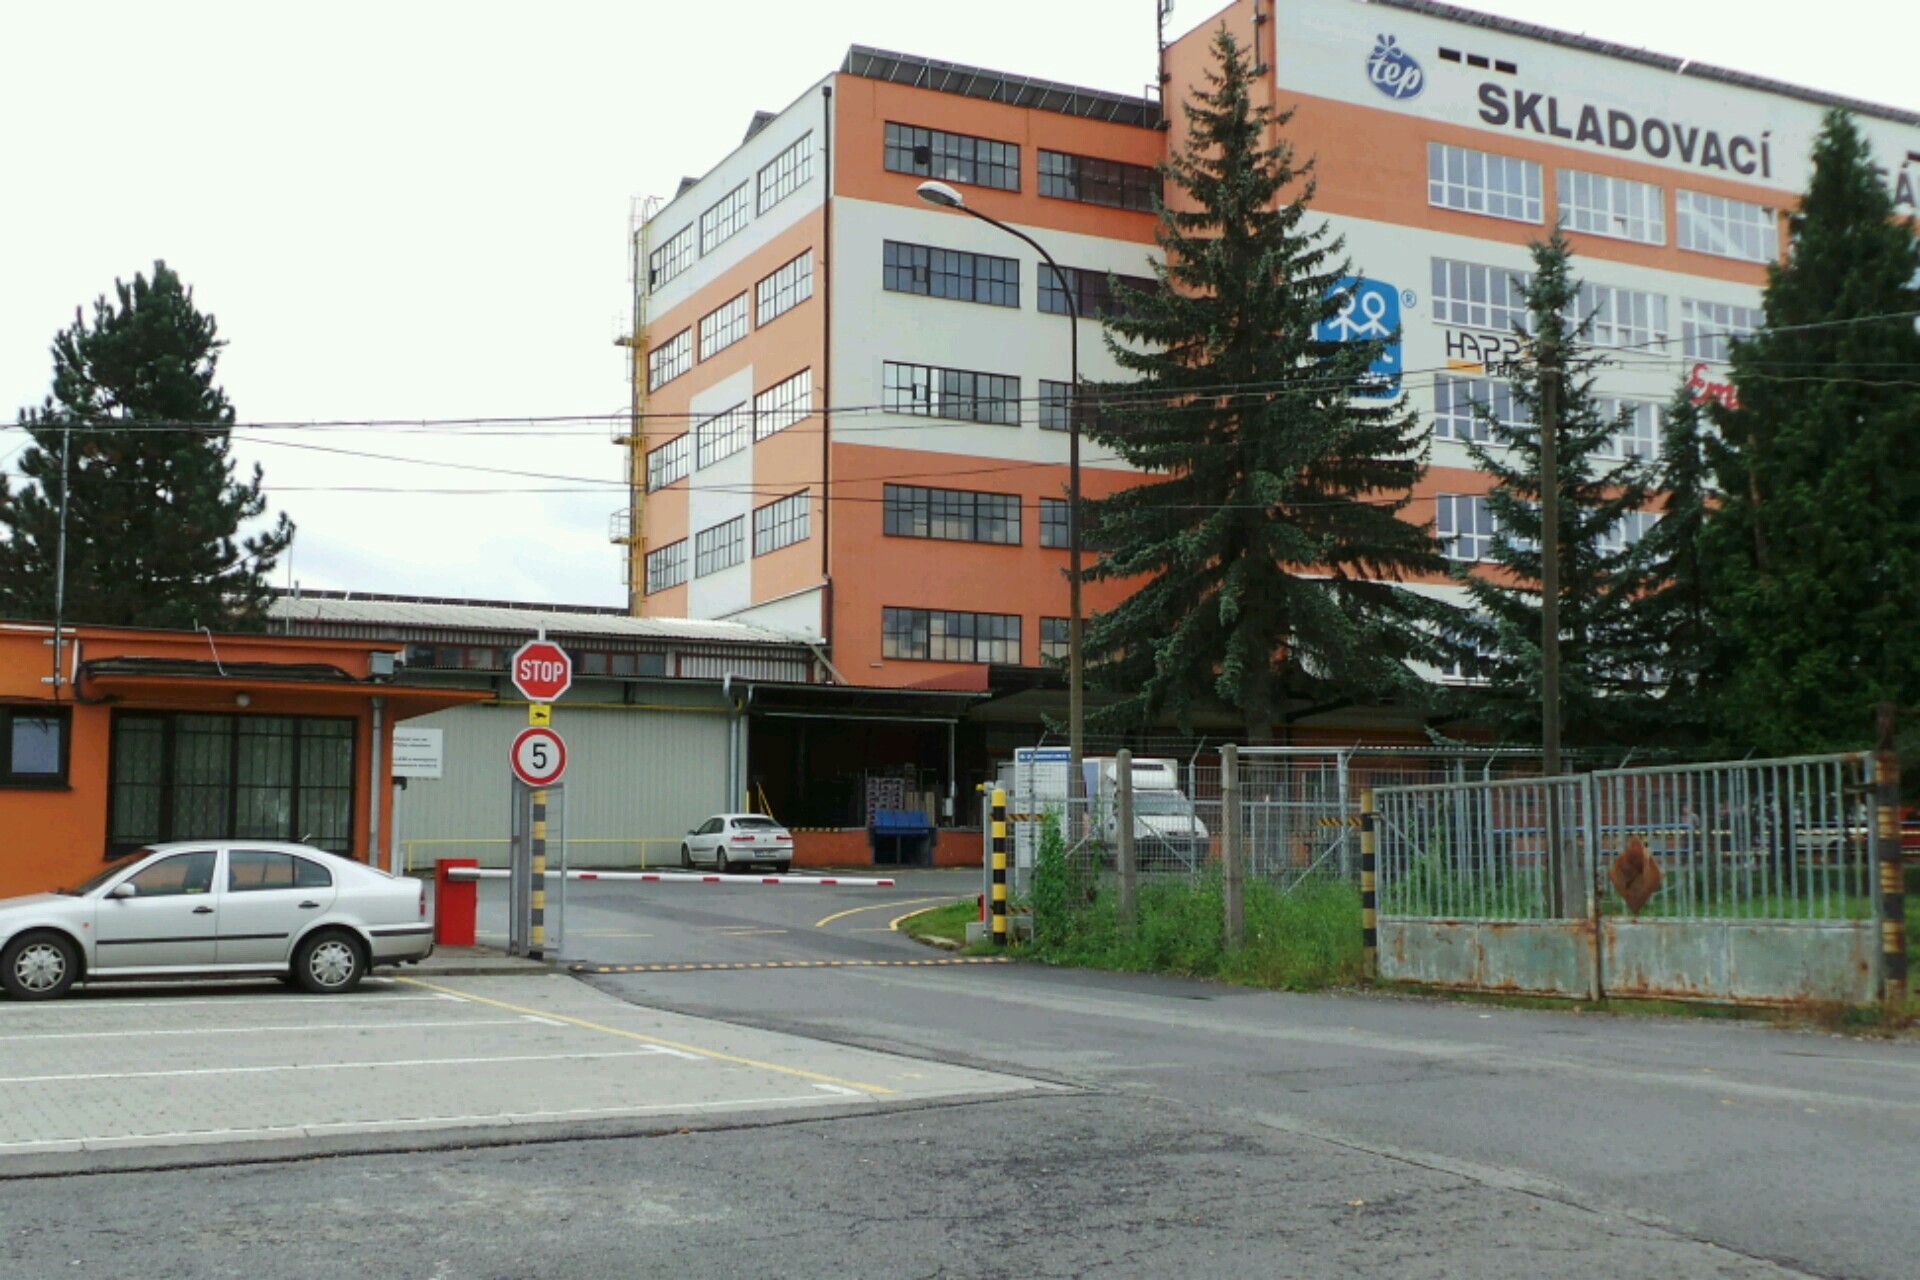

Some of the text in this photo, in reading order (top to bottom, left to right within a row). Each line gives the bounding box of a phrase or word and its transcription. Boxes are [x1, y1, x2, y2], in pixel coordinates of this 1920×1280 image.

[1368, 56, 1422, 97] tep
[1478, 82, 1773, 178] SKLADOVACÍ
[520, 659, 564, 682] STOP
[532, 742, 547, 769] 5
